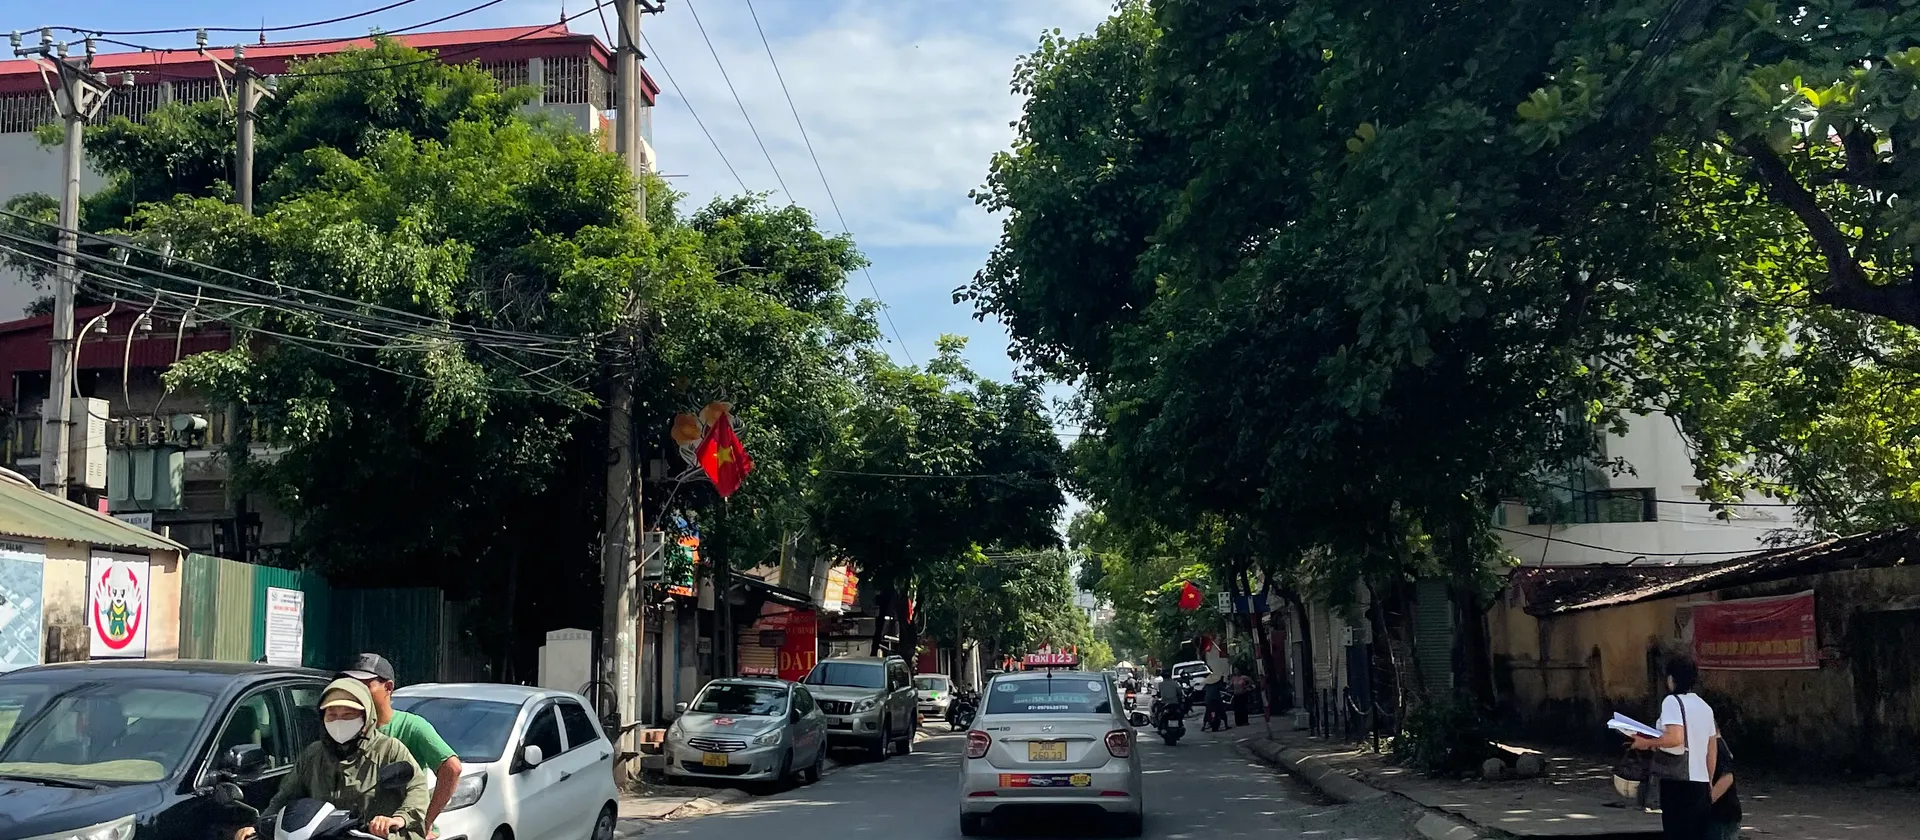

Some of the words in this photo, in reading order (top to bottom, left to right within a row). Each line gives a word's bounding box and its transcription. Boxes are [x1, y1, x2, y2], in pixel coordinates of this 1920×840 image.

[1028, 653, 1049, 663] Taxi
[1051, 653, 1073, 663] 123
[1032, 751, 1063, 760] 260.33
